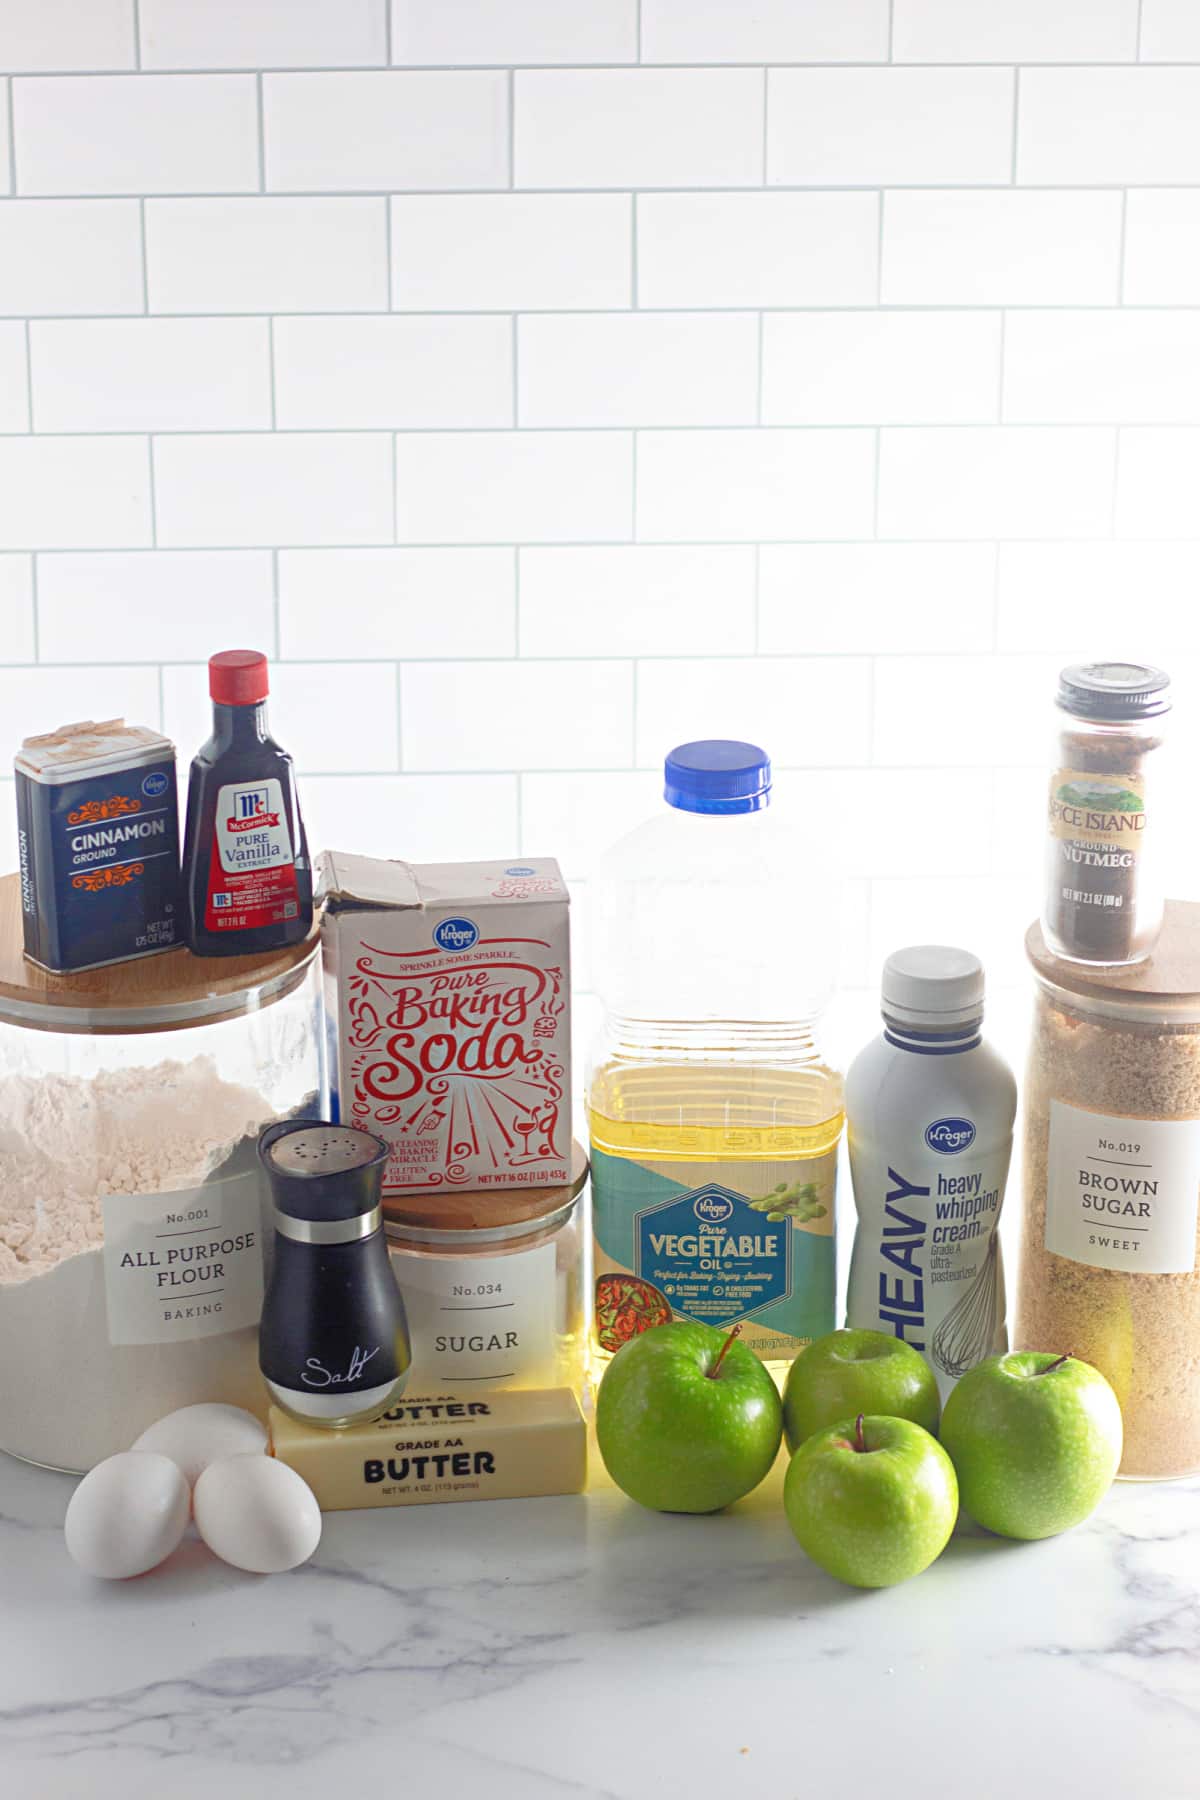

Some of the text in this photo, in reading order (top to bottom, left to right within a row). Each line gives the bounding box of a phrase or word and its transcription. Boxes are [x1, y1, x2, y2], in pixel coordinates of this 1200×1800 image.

[229, 815, 274, 831] McCormick
[71, 819, 166, 851] CINNAMON
[236, 832, 270, 847] PURE
[225, 843, 280, 862] Vanilla
[1073, 839, 1118, 852] GROUND
[72, 847, 117, 865] GROUND
[238, 857, 272, 868] EXTRACT
[1062, 844, 1133, 868] NUTMEG
[19, 829, 30, 912] CINNAMON
[441, 925, 474, 947] Kroger
[399, 959, 445, 971] SPRINKLE
[446, 954, 471, 964] SOME
[430, 971, 490, 996] Pure
[386, 985, 530, 1031] Baking
[363, 1016, 544, 1101] Soda
[929, 1126, 973, 1148] Kroger
[1098, 1138, 1142, 1153] No.019
[390, 1154, 438, 1164] MIRACLE
[389, 1166, 428, 1175] GLUTEN
[389, 1174, 411, 1183] FREE
[478, 1175, 492, 1184] NET
[494, 1173, 507, 1182] WT
[508, 1173, 516, 1182] 16
[517, 1172, 528, 1181] OZ
[937, 1172, 983, 1197] heavy
[1078, 1169, 1160, 1196] BROWN
[699, 1198, 727, 1218] Kroger
[936, 1188, 999, 1223] whipping
[1082, 1193, 1151, 1217] SUGAR
[167, 1209, 209, 1224] No.001
[698, 1223, 728, 1235] Pure
[932, 1219, 982, 1244] cream
[120, 1232, 256, 1268] ALL PURPOSE
[649, 1234, 778, 1257] VEGETABLE
[1088, 1235, 1141, 1251] SWEET
[700, 1258, 722, 1270] OIL
[879, 1166, 931, 1352] HEAVY
[930, 1256, 953, 1270] ultra-
[157, 1263, 225, 1287] FLOUR
[931, 1264, 977, 1285] pasteurized
[452, 1283, 503, 1297] No.034
[164, 1303, 223, 1321] BAKING
[435, 1331, 520, 1353] SUGAR
[300, 1345, 380, 1387] Salt
[369, 1402, 491, 1424] UTTER
[395, 1438, 464, 1451] GRADE AA
[364, 1451, 496, 1484] BUTTER
[382, 1487, 396, 1495] NET
